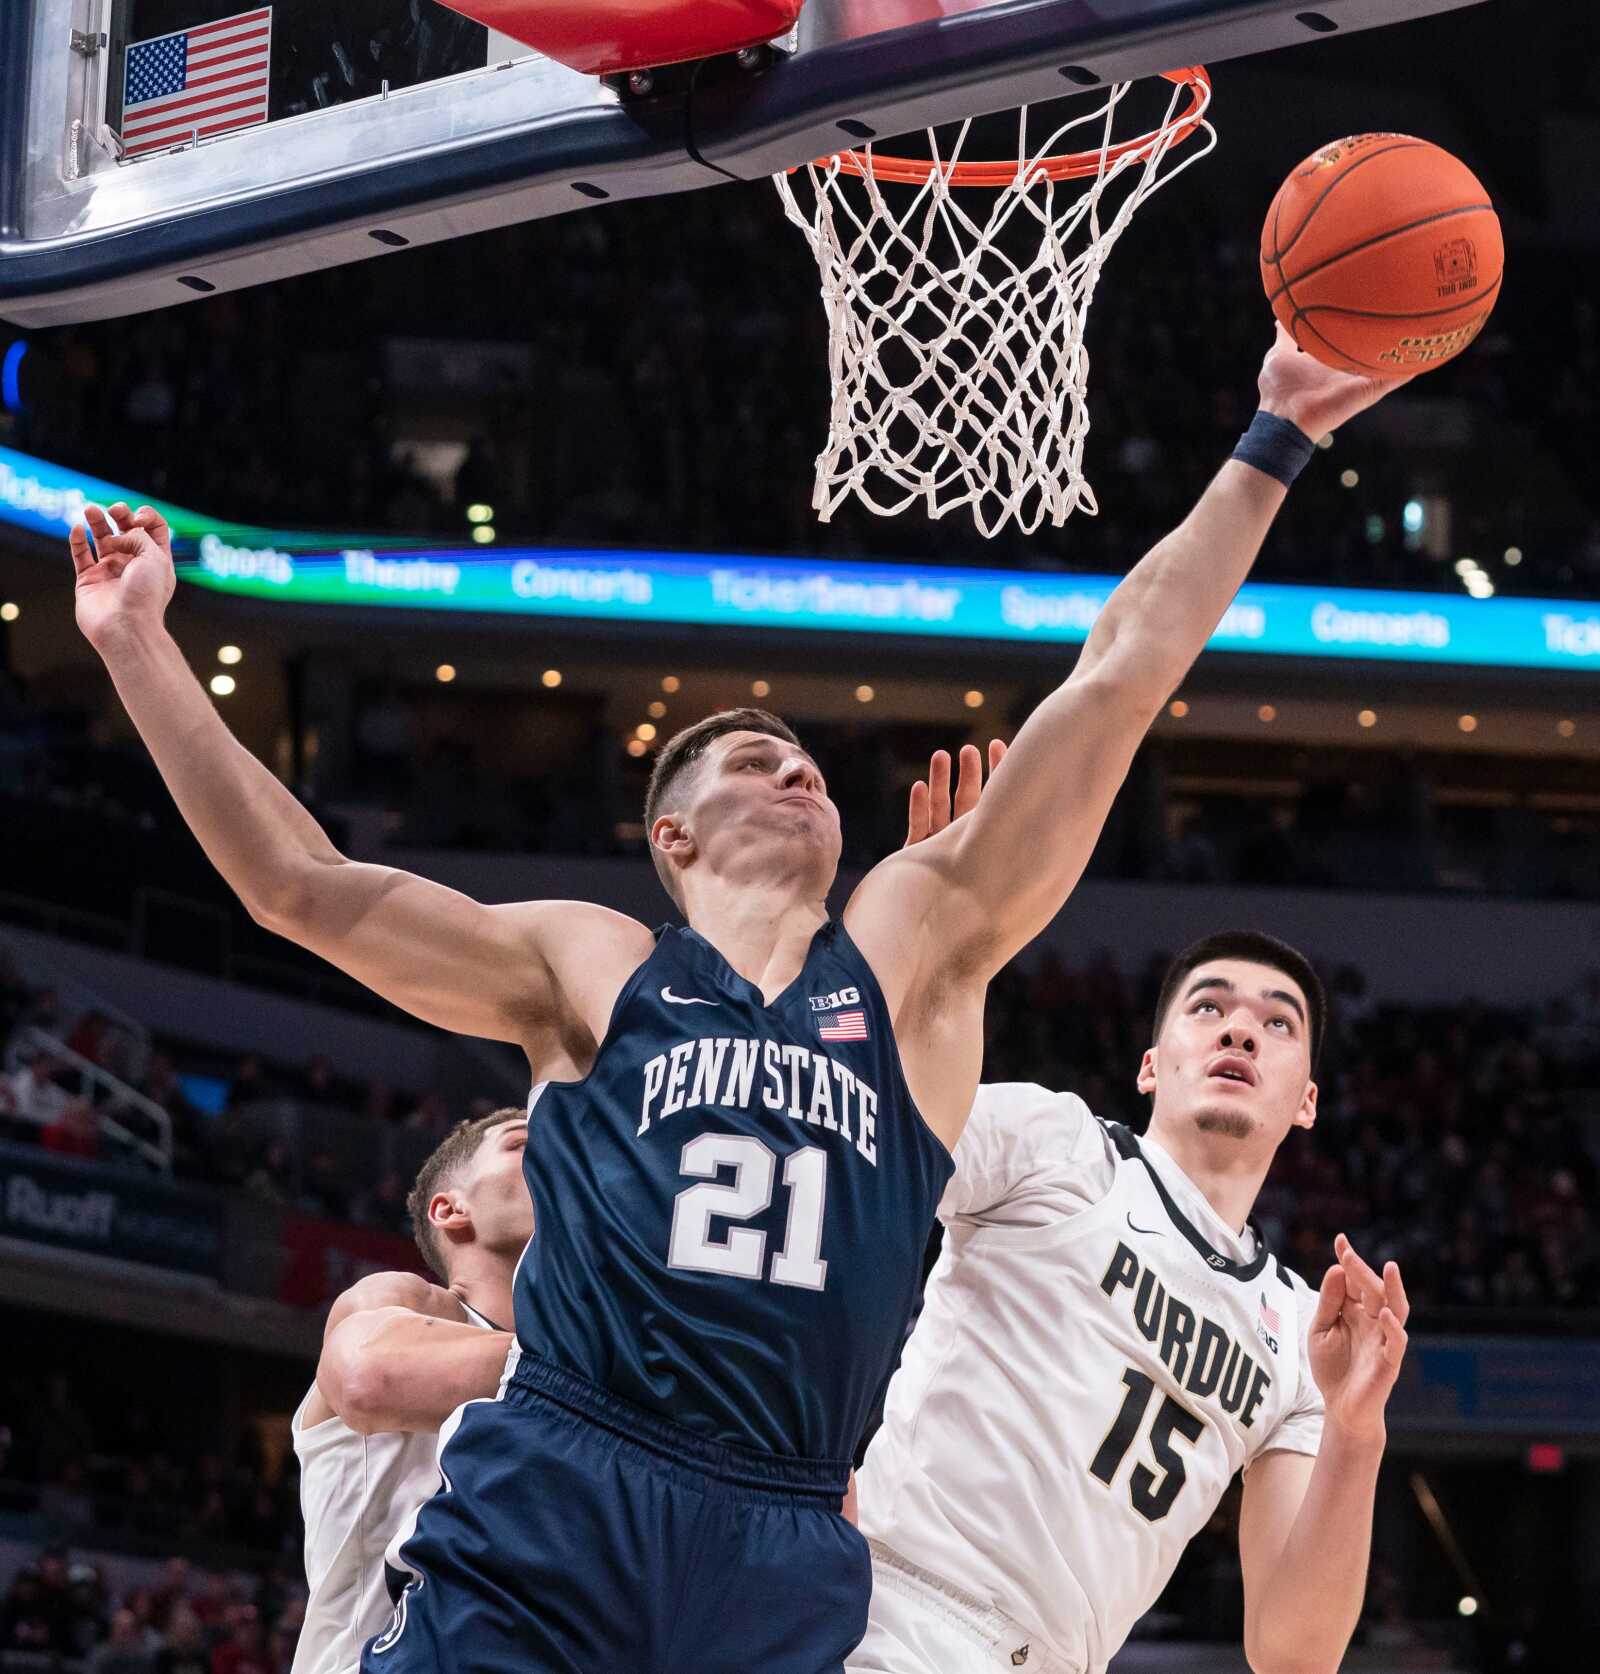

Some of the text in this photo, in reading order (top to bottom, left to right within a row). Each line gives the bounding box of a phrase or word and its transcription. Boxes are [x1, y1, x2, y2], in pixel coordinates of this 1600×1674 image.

[636, 1037, 878, 1168] PENN STATE
[667, 1132, 828, 1291] 21
[1099, 1239, 1272, 1430] PURDUE
[1088, 1366, 1206, 1526] 15
